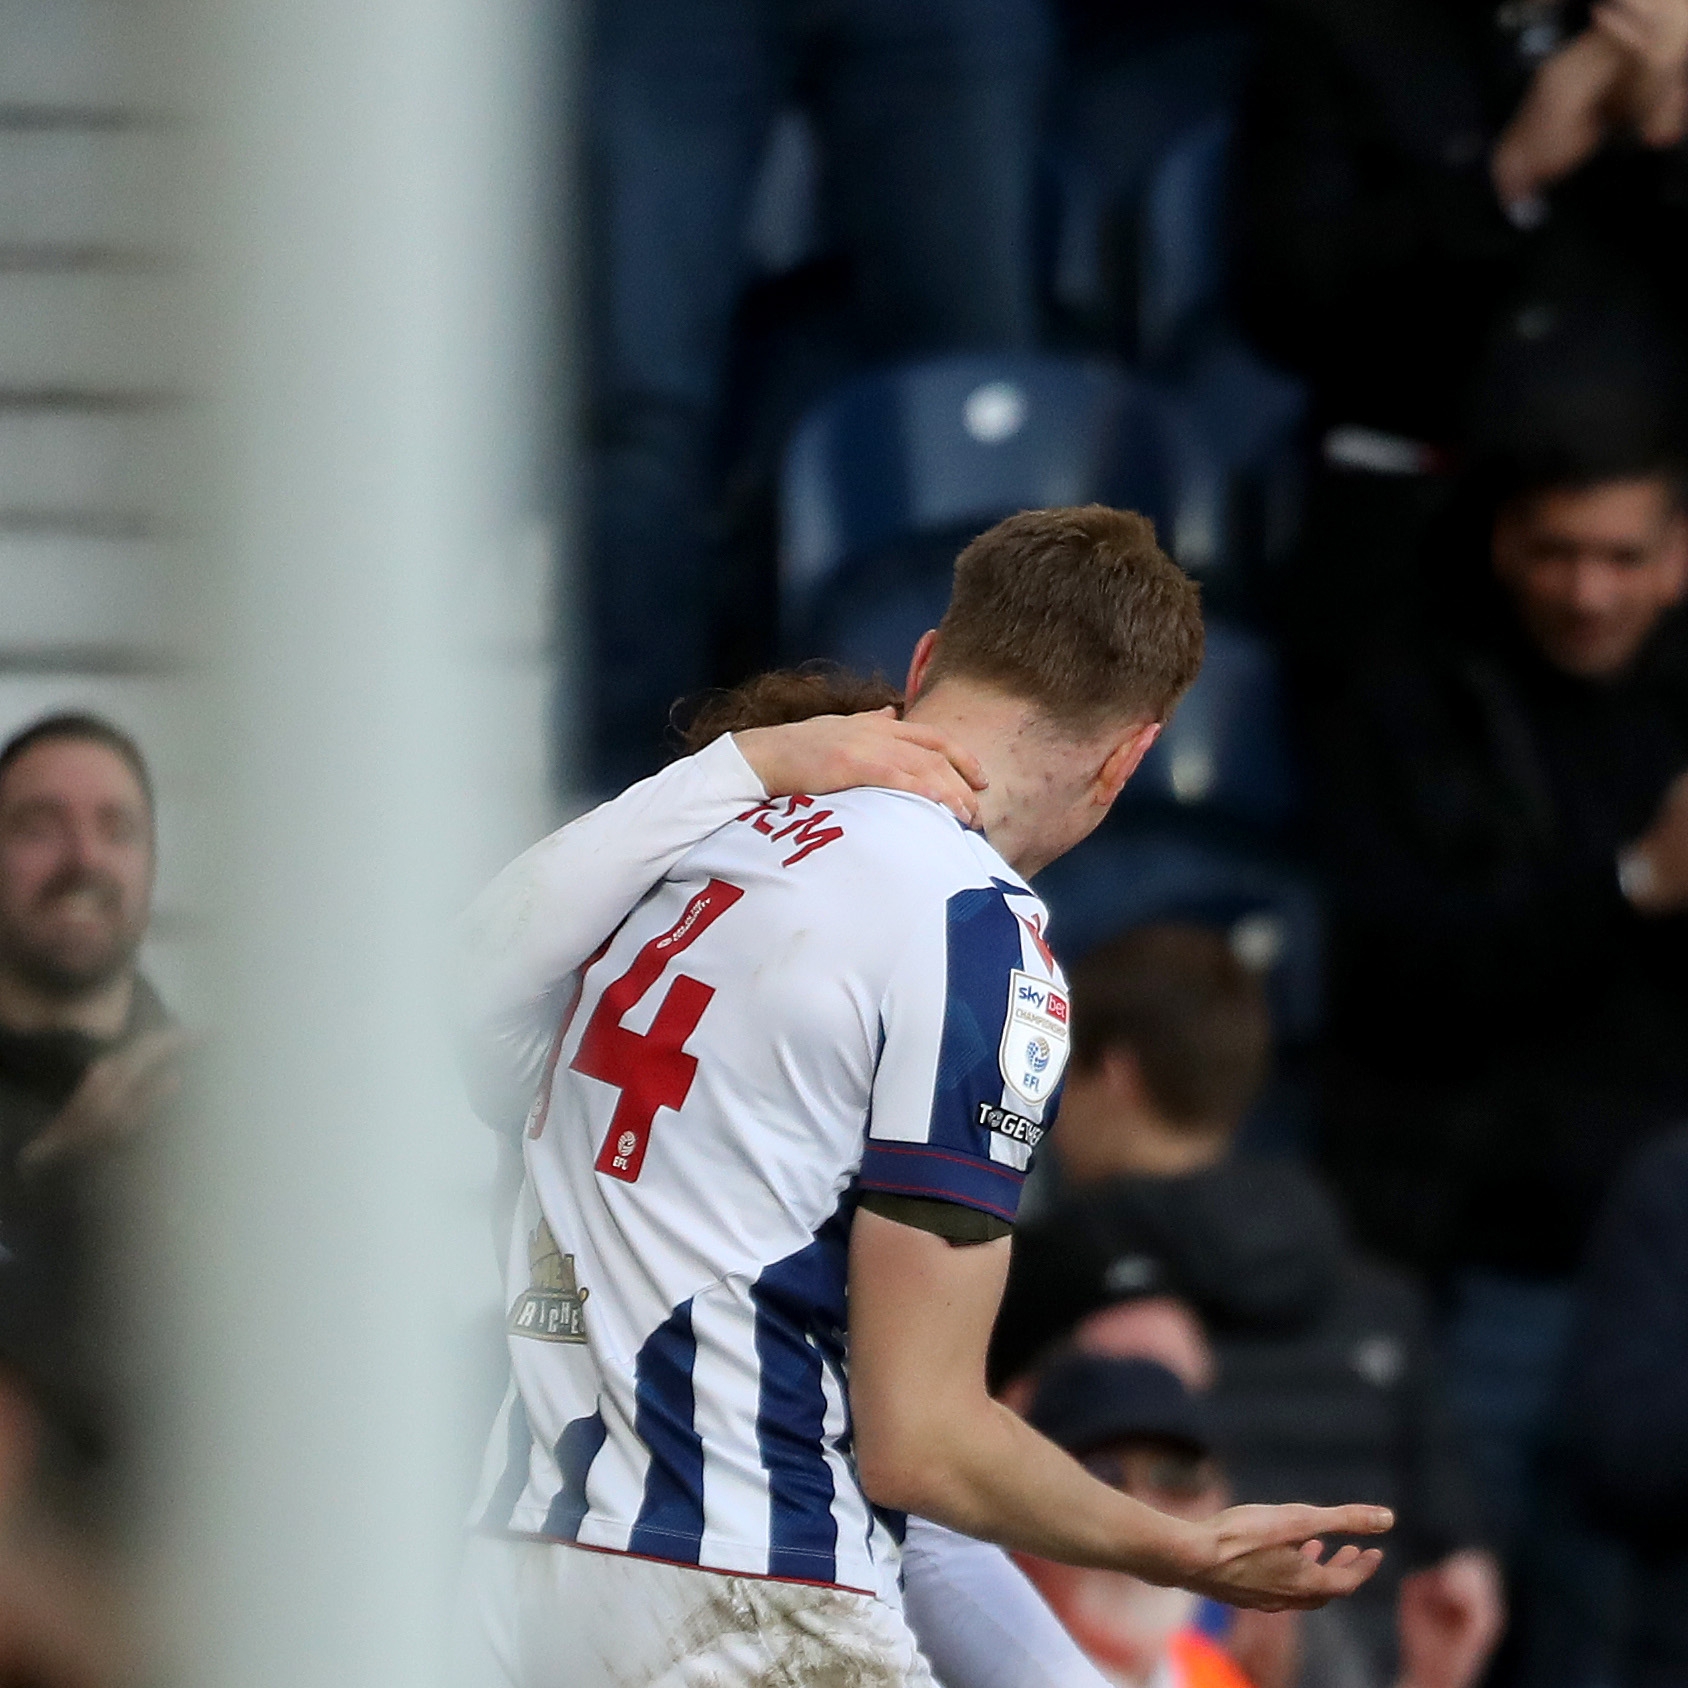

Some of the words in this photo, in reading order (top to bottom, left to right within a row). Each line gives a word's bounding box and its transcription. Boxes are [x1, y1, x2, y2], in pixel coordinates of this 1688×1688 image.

[1018, 985, 1046, 1009] sky
[1047, 993, 1067, 1019] bet
[1014, 1007, 1068, 1038] CHAMPIONSHIP
[1022, 1072, 1041, 1093] EFL
[611, 1154, 631, 1171] EFL
